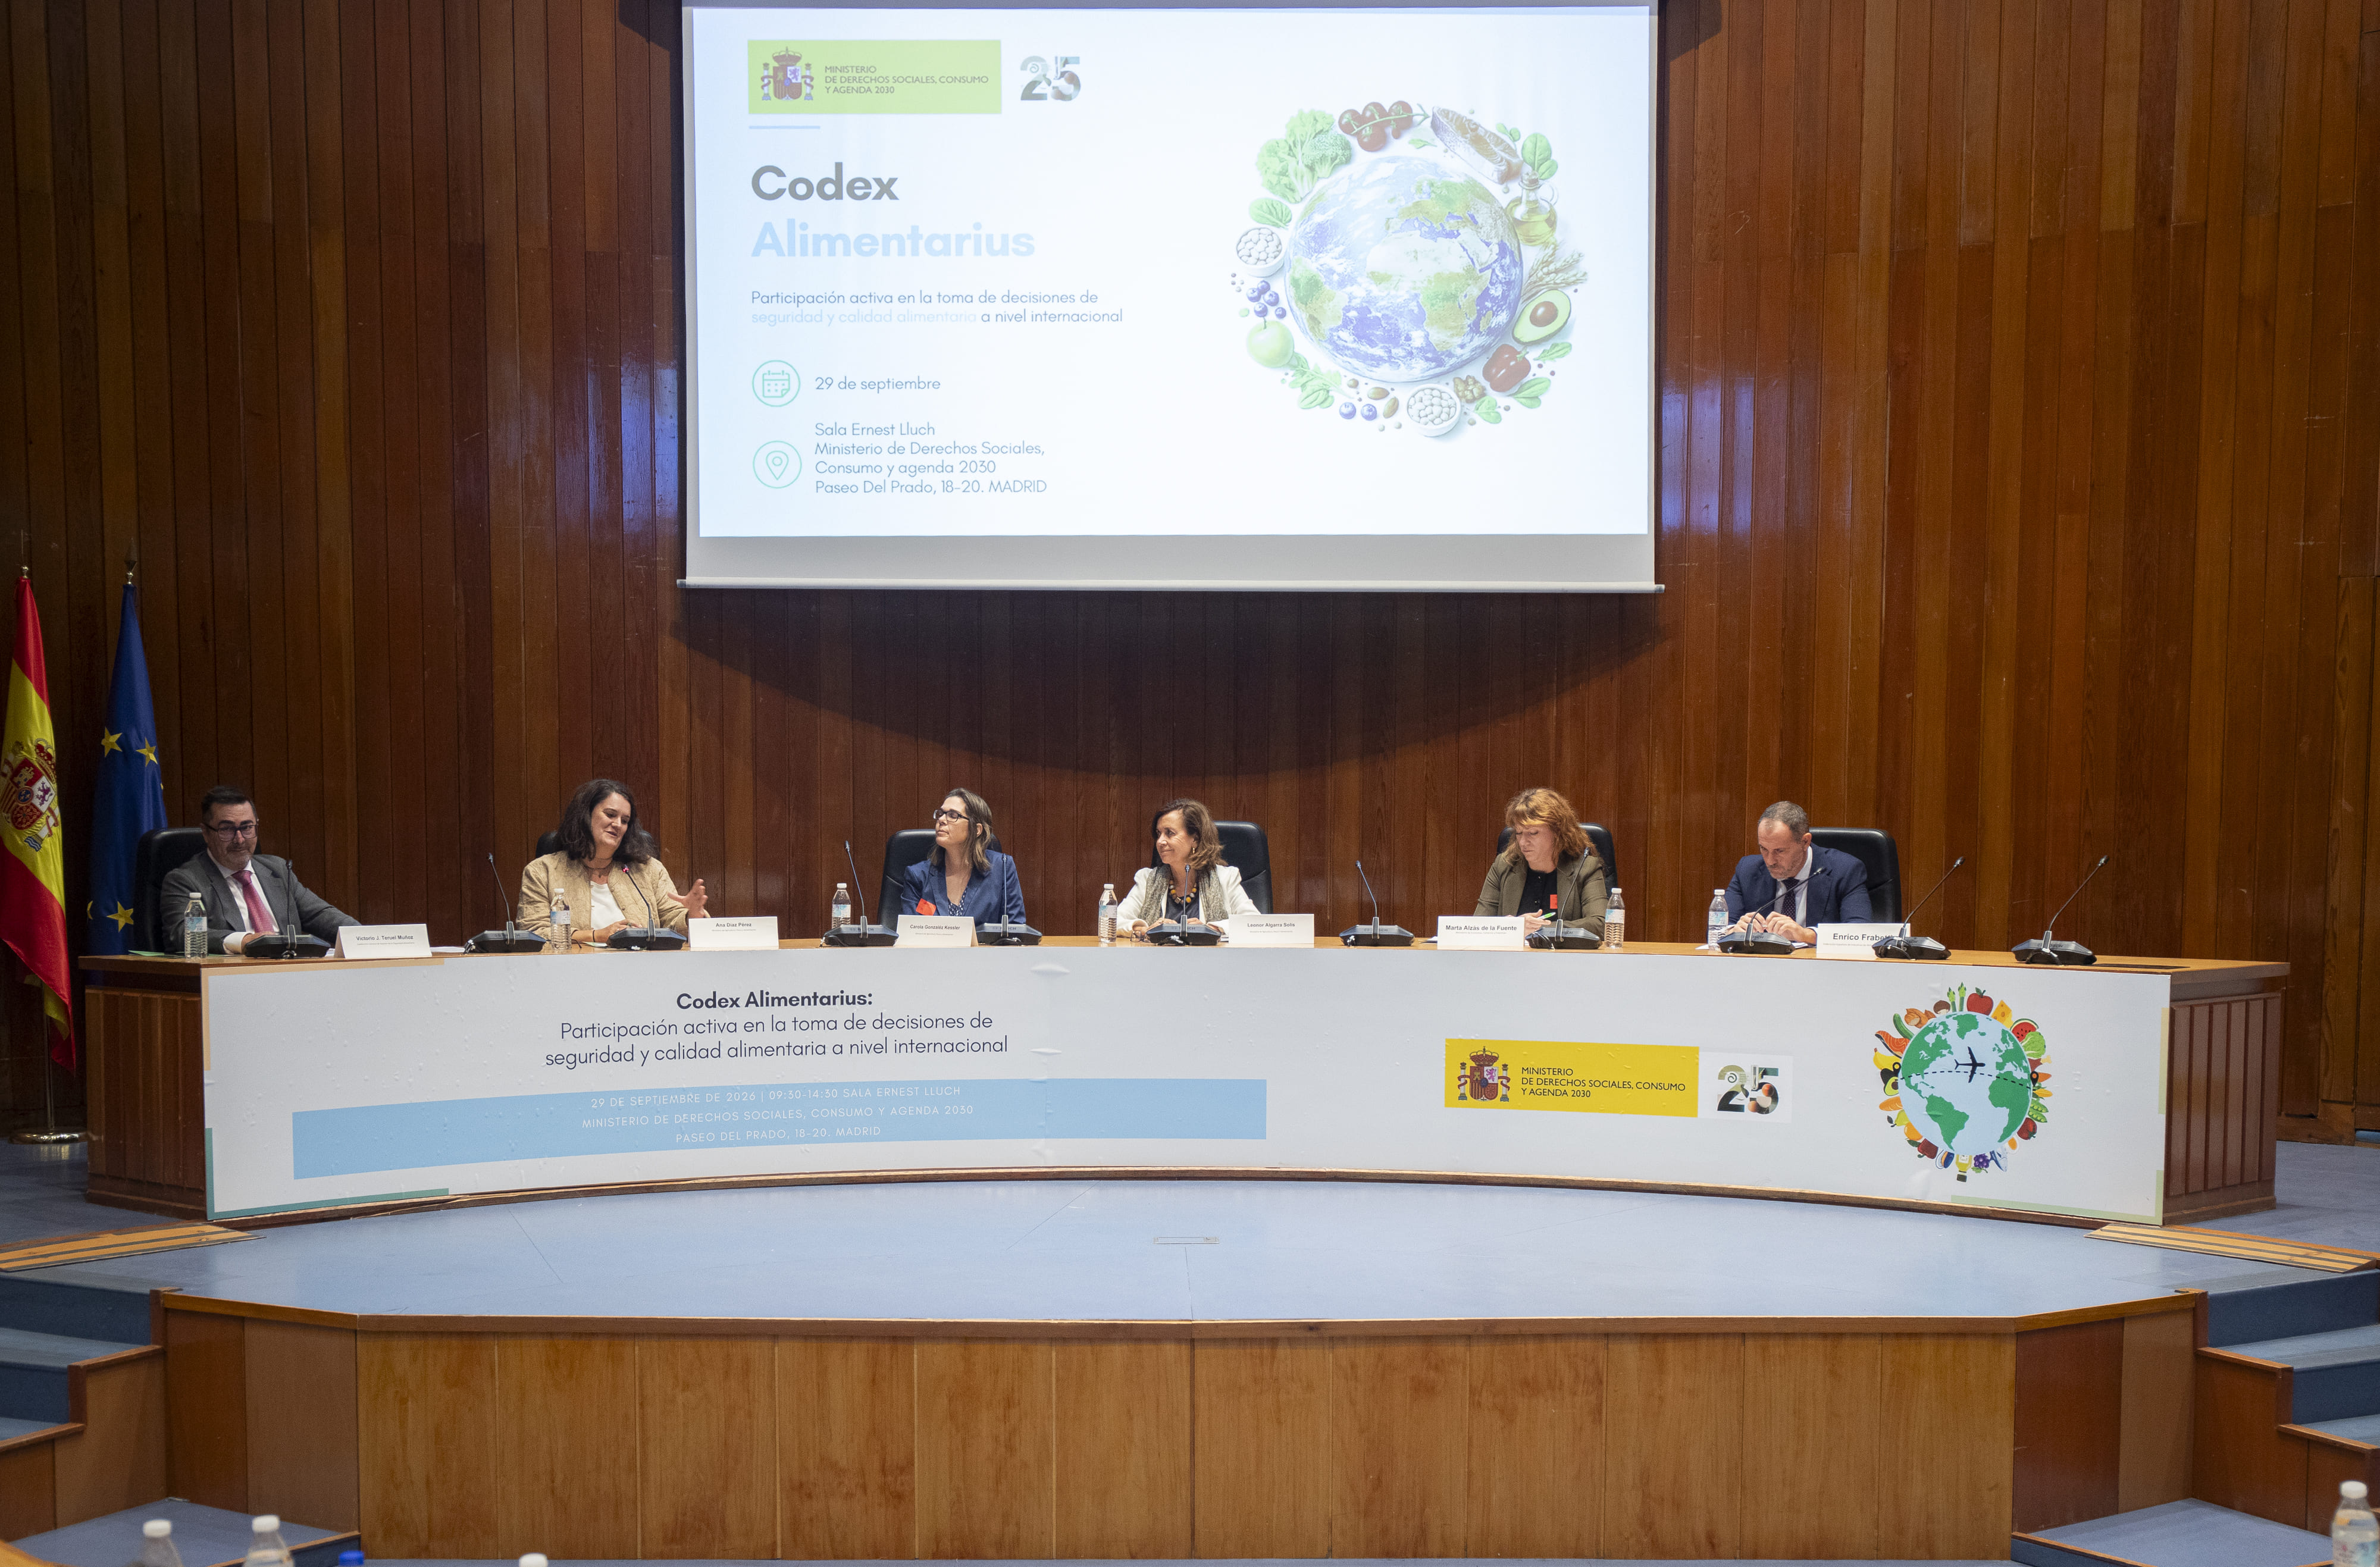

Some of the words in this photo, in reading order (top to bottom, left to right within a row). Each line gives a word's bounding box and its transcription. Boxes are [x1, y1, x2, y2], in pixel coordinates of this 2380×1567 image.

[825, 65, 877, 74] MINISTERIO
[1020, 55, 1081, 101] 25
[825, 76, 838, 84] DE
[840, 76, 890, 84] DERECHOS
[892, 76, 937, 86] SOCIALES,
[939, 75, 989, 84] CONSUMO
[825, 86, 831, 95] Y
[832, 86, 873, 95] AGENDA
[875, 86, 895, 95] 2030
[751, 162, 900, 202] Codex
[750, 218, 1035, 258] Alimentarius
[751, 290, 845, 308] Participación
[849, 292, 893, 305] activa
[897, 295, 915, 305] en
[919, 290, 932, 305] la
[937, 292, 973, 304] toma
[978, 290, 997, 304] de
[1001, 290, 1076, 304] decisiones
[1080, 290, 1098, 304] de
[751, 309, 823, 327] seguridad
[827, 314, 835, 327] y
[838, 309, 892, 323] calidad
[897, 309, 977, 323] alimentaria
[981, 314, 991, 323] a
[995, 309, 1026, 323] nivel
[1031, 308, 1123, 323] internacional
[815, 377, 834, 391] 29
[838, 376, 857, 391] de
[860, 376, 941, 395] septiembre
[815, 422, 847, 437] Sala
[851, 423, 895, 437] Ernest
[900, 422, 935, 436] Lluch
[815, 442, 883, 456] Ministerio
[887, 441, 906, 456] de
[910, 441, 978, 455] Derechos
[982, 440, 1045, 457] Sociales,
[815, 461, 883, 475] Consumo
[887, 465, 895, 477] y
[898, 459, 954, 477] agenda
[959, 460, 996, 474] 2030
[816, 481, 859, 494] Paseo
[863, 479, 886, 494] Del
[891, 479, 937, 496] Prado,
[941, 480, 984, 494] 18-20.
[988, 480, 1047, 493] MADRID
[677, 991, 741, 1010] Codex
[744, 990, 873, 1008] Alimentarius:
[560, 1019, 678, 1042] Participación
[684, 1018, 737, 1035] activa
[743, 1021, 765, 1033] en
[771, 1015, 786, 1033] la
[791, 1017, 837, 1032] toma
[844, 1013, 866, 1031] de
[872, 1011, 964, 1030] decisiones
[970, 1011, 993, 1029] de
[545, 1044, 635, 1070] seguridad
[640, 1050, 650, 1067] y
[654, 1042, 721, 1062] calidad
[727, 1040, 826, 1057] alimentaria
[832, 1044, 843, 1055] a
[849, 1038, 888, 1055] nivel
[894, 1035, 1008, 1054] internacional
[1521, 1067, 1574, 1076] MINISTERIO
[1529, 1088, 1568, 1096] AGENDA
[1536, 1078, 1586, 1088] DERECHOS
[1589, 1079, 1634, 1090] SOCIALES,
[1636, 1082, 1686, 1091] CONSUMO
[1717, 1064, 1779, 1114] 25
[591, 1099, 605, 1108] 29
[610, 1098, 625, 1107] DE
[630, 1093, 700, 1106] SEPTIEMBRE
[706, 1093, 720, 1102] DE
[726, 1091, 756, 1101] 2026
[769, 1089, 838, 1101] 09:30-14:30
[843, 1088, 872, 1098] SALA
[876, 1087, 919, 1097] ERNEST
[925, 1086, 960, 1096] LLUCH
[582, 1116, 649, 1129] MINISTERIO
[654, 1115, 669, 1124] DE
[674, 1112, 739, 1124] DERECHOS
[744, 1110, 806, 1121] SOCIALES,
[811, 1107, 873, 1118] CONSUMO
[879, 1107, 885, 1116] Y
[890, 1106, 940, 1116] AGENDA
[945, 1105, 973, 1115] 2030
[676, 1133, 715, 1143] PASEO
[721, 1132, 741, 1141] DEL
[746, 1130, 790, 1140] PRADO,
[795, 1129, 831, 1138] 18-20.
[835, 1127, 881, 1137] MADRID
